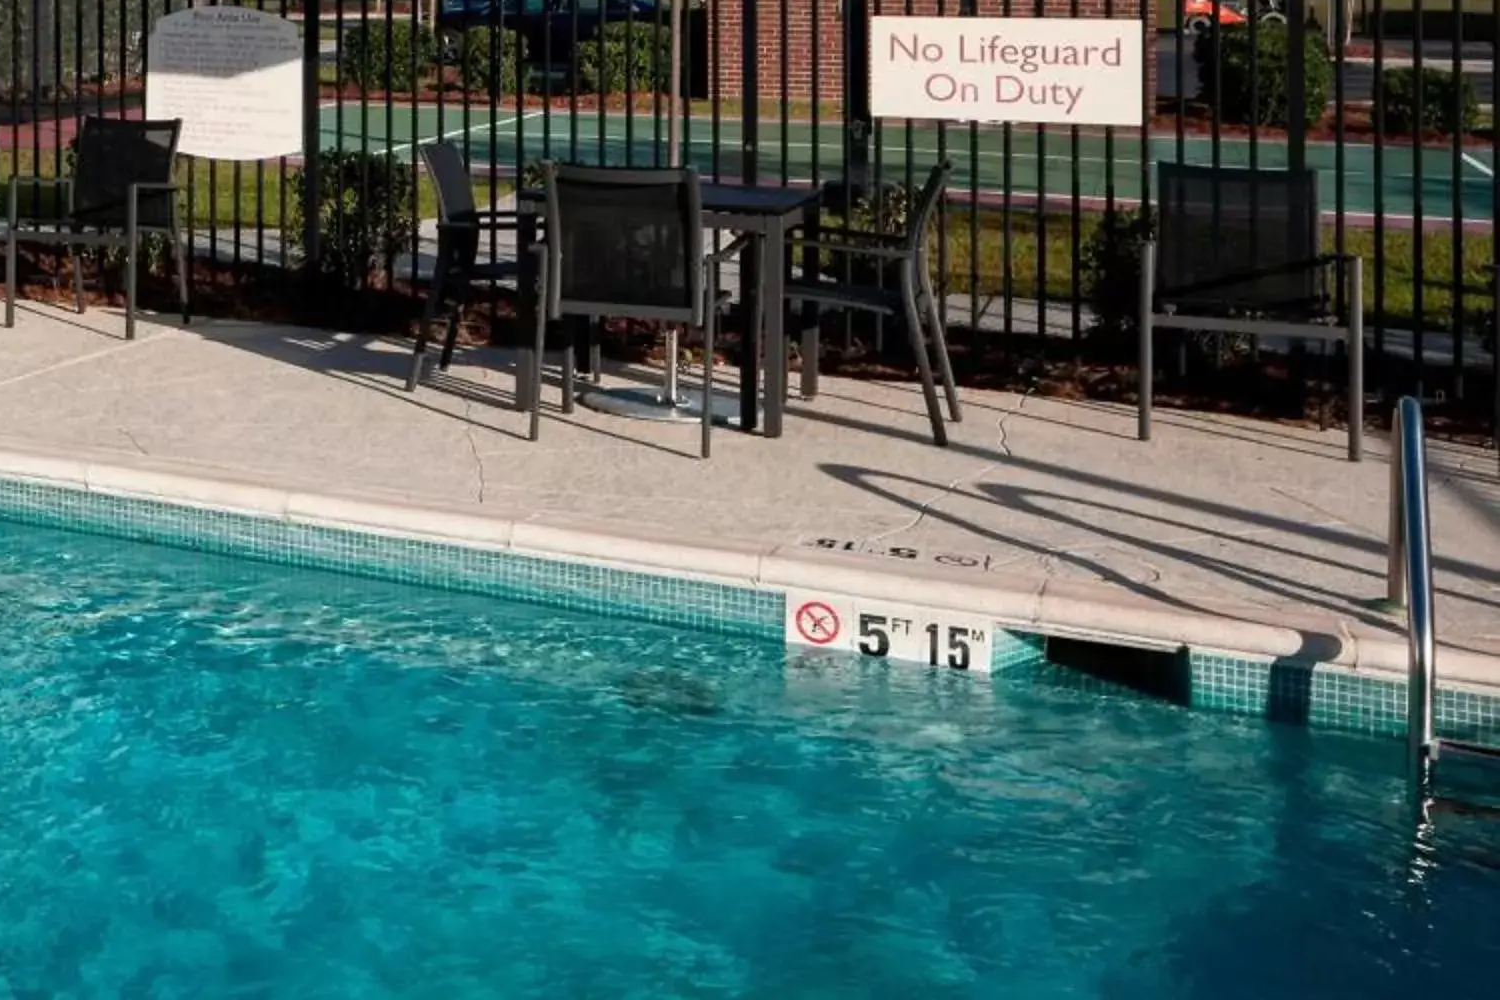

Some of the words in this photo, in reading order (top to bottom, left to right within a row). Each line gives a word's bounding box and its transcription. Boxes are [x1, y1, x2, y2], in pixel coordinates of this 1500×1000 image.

[889, 32, 943, 63] No
[959, 34, 1122, 73] Lifeguard
[924, 73, 979, 104] On
[995, 75, 1084, 115] Duty
[859, 613, 890, 657] 5
[891, 616, 913, 637] FT
[925, 622, 970, 670] 15
[971, 629, 986, 642] M
